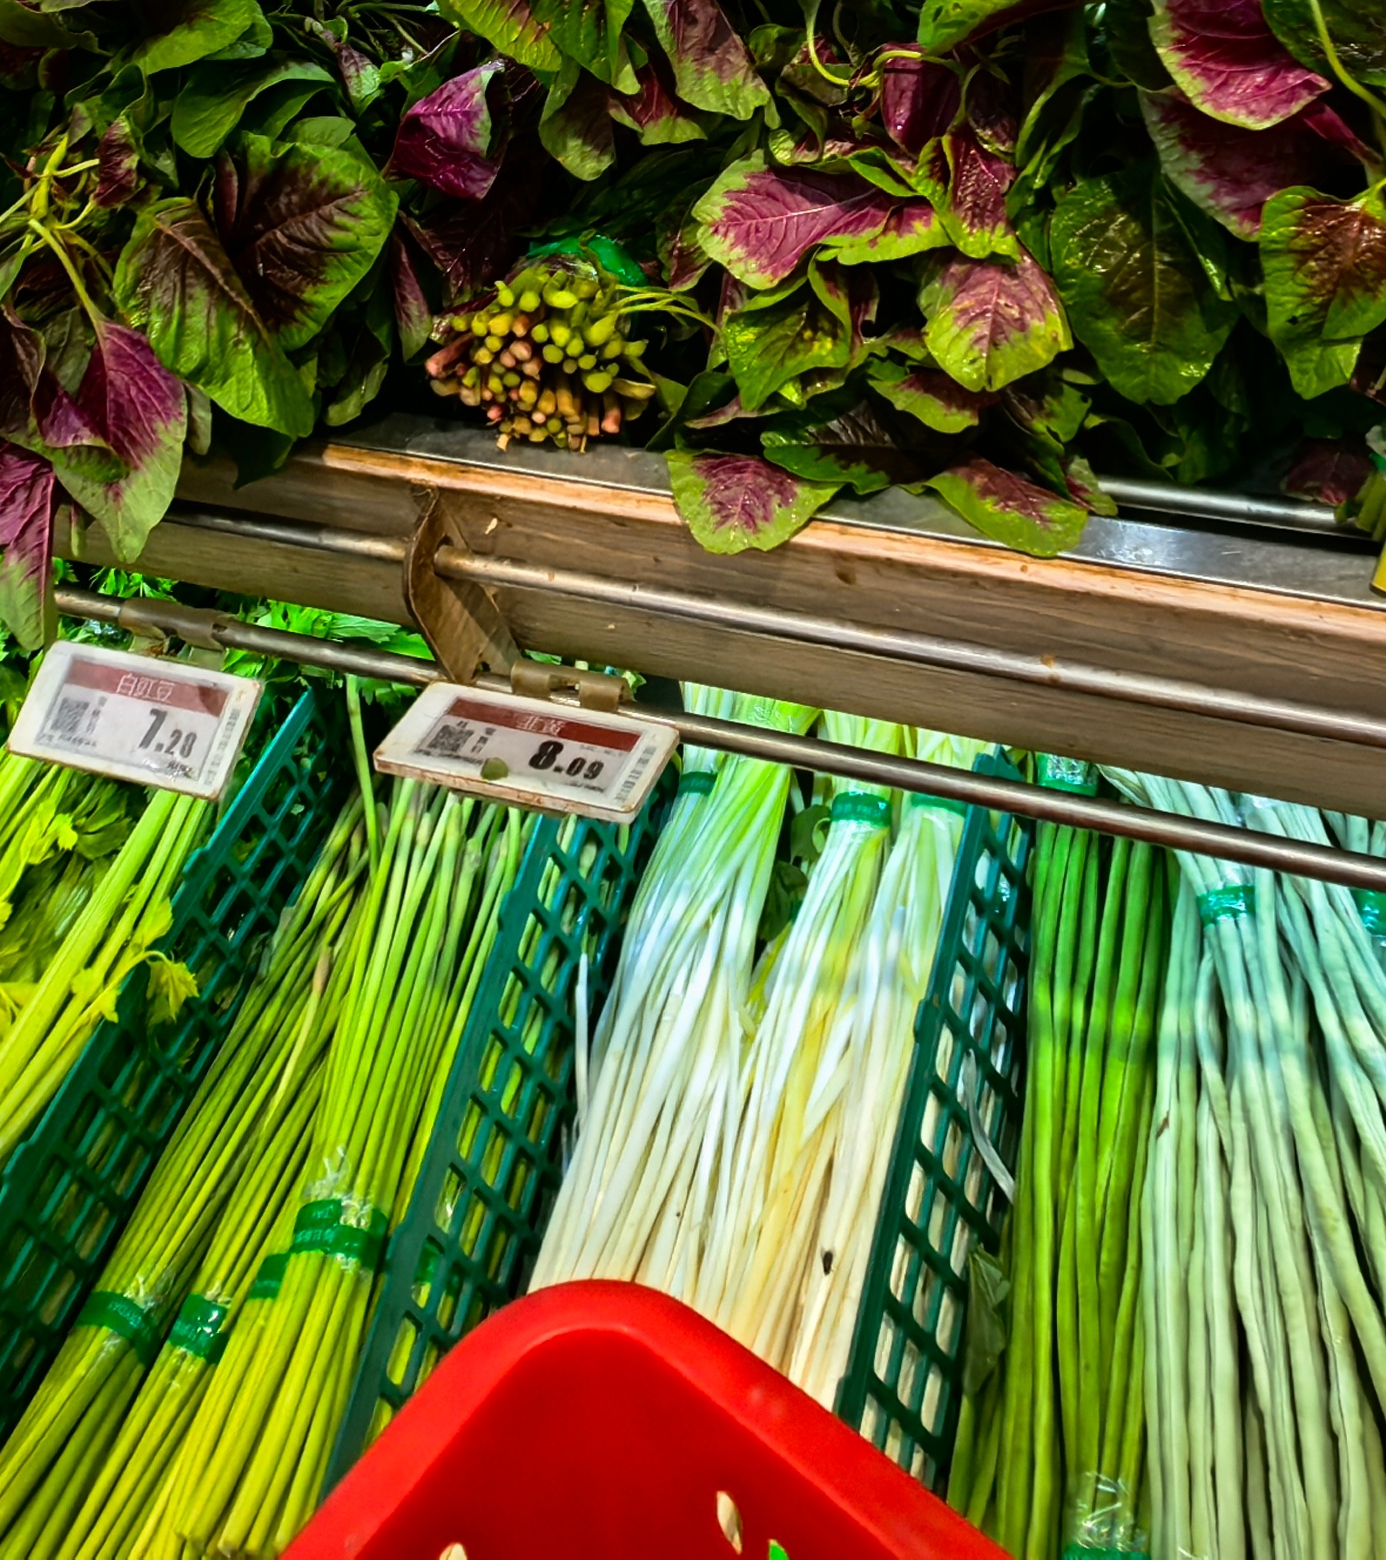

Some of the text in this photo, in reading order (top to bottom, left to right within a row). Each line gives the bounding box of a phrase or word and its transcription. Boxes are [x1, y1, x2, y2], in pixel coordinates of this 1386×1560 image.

[115, 672, 176, 703] 白豇豆
[527, 740, 605, 781] 8.09
